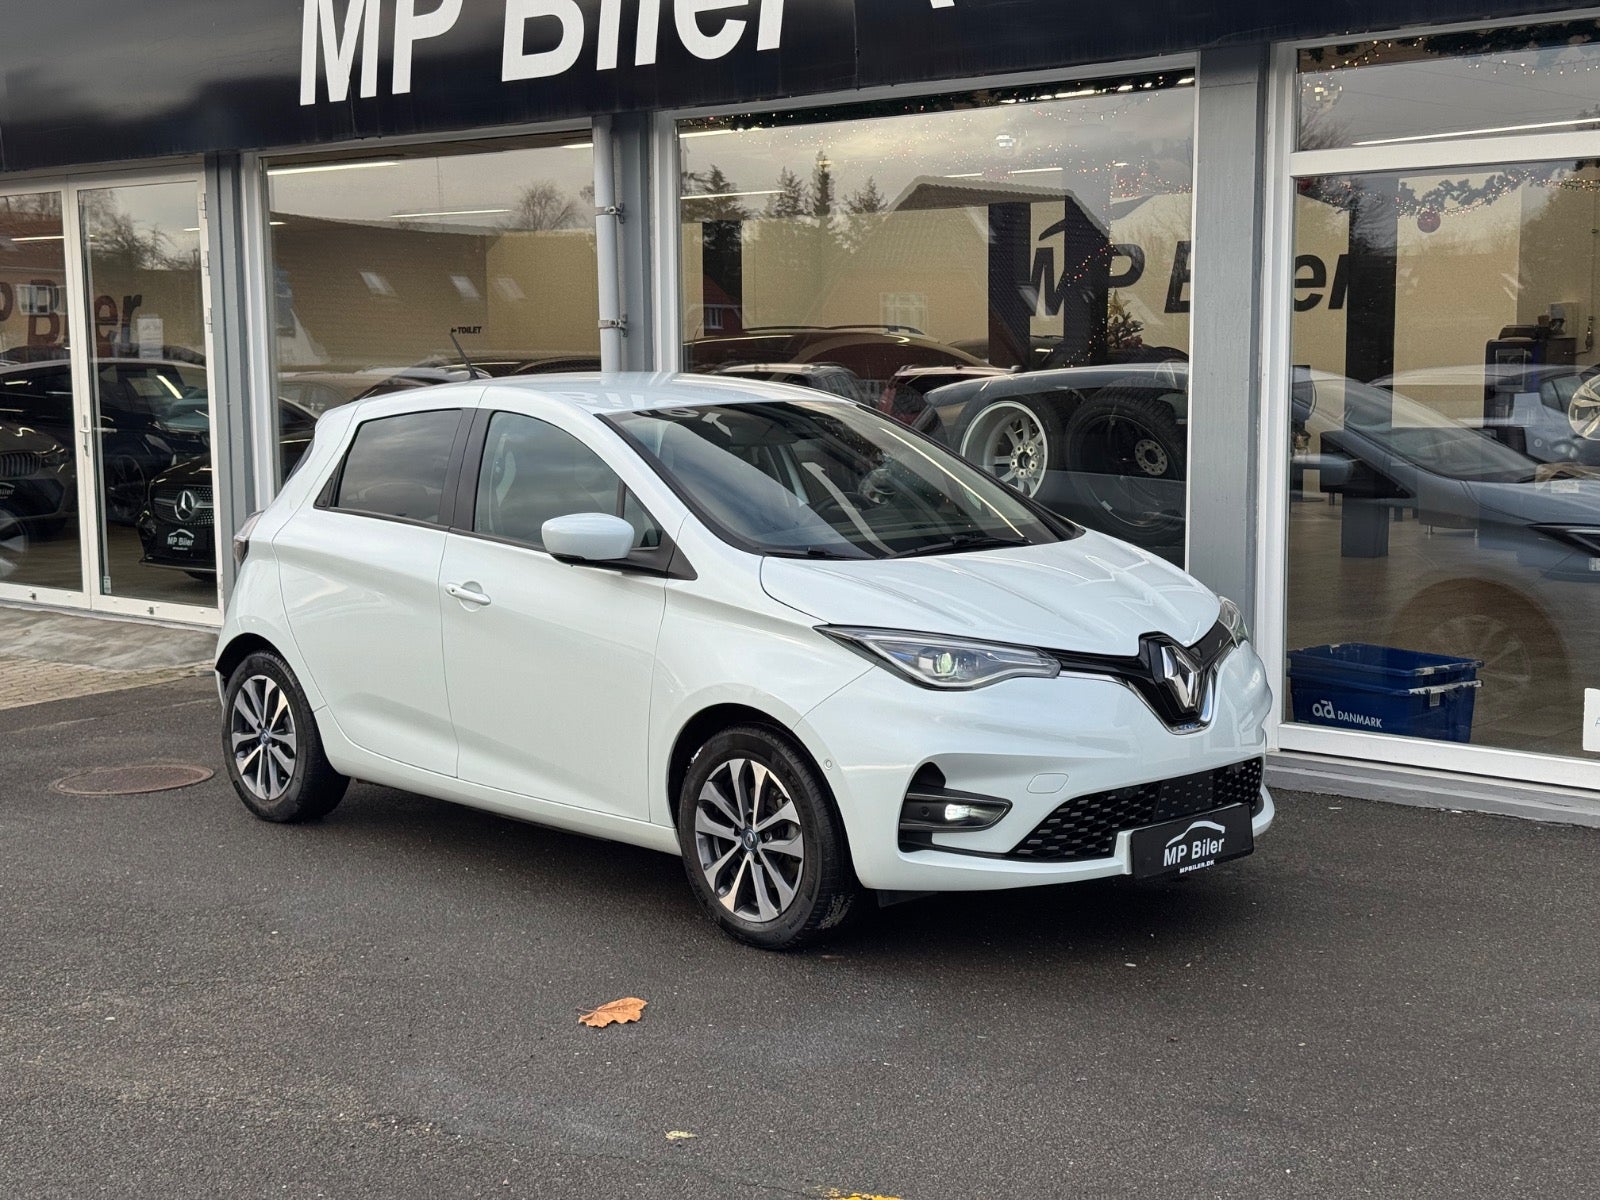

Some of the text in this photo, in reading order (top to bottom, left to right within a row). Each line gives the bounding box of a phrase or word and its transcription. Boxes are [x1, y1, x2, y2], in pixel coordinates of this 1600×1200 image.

[300, 0, 464, 106] MP
[457, 326, 482, 335] TOILET
[1337, 710, 1383, 729] DANMARK
[1163, 837, 1225, 867] MP Biler
[1179, 859, 1215, 874] MPBILER.DK
